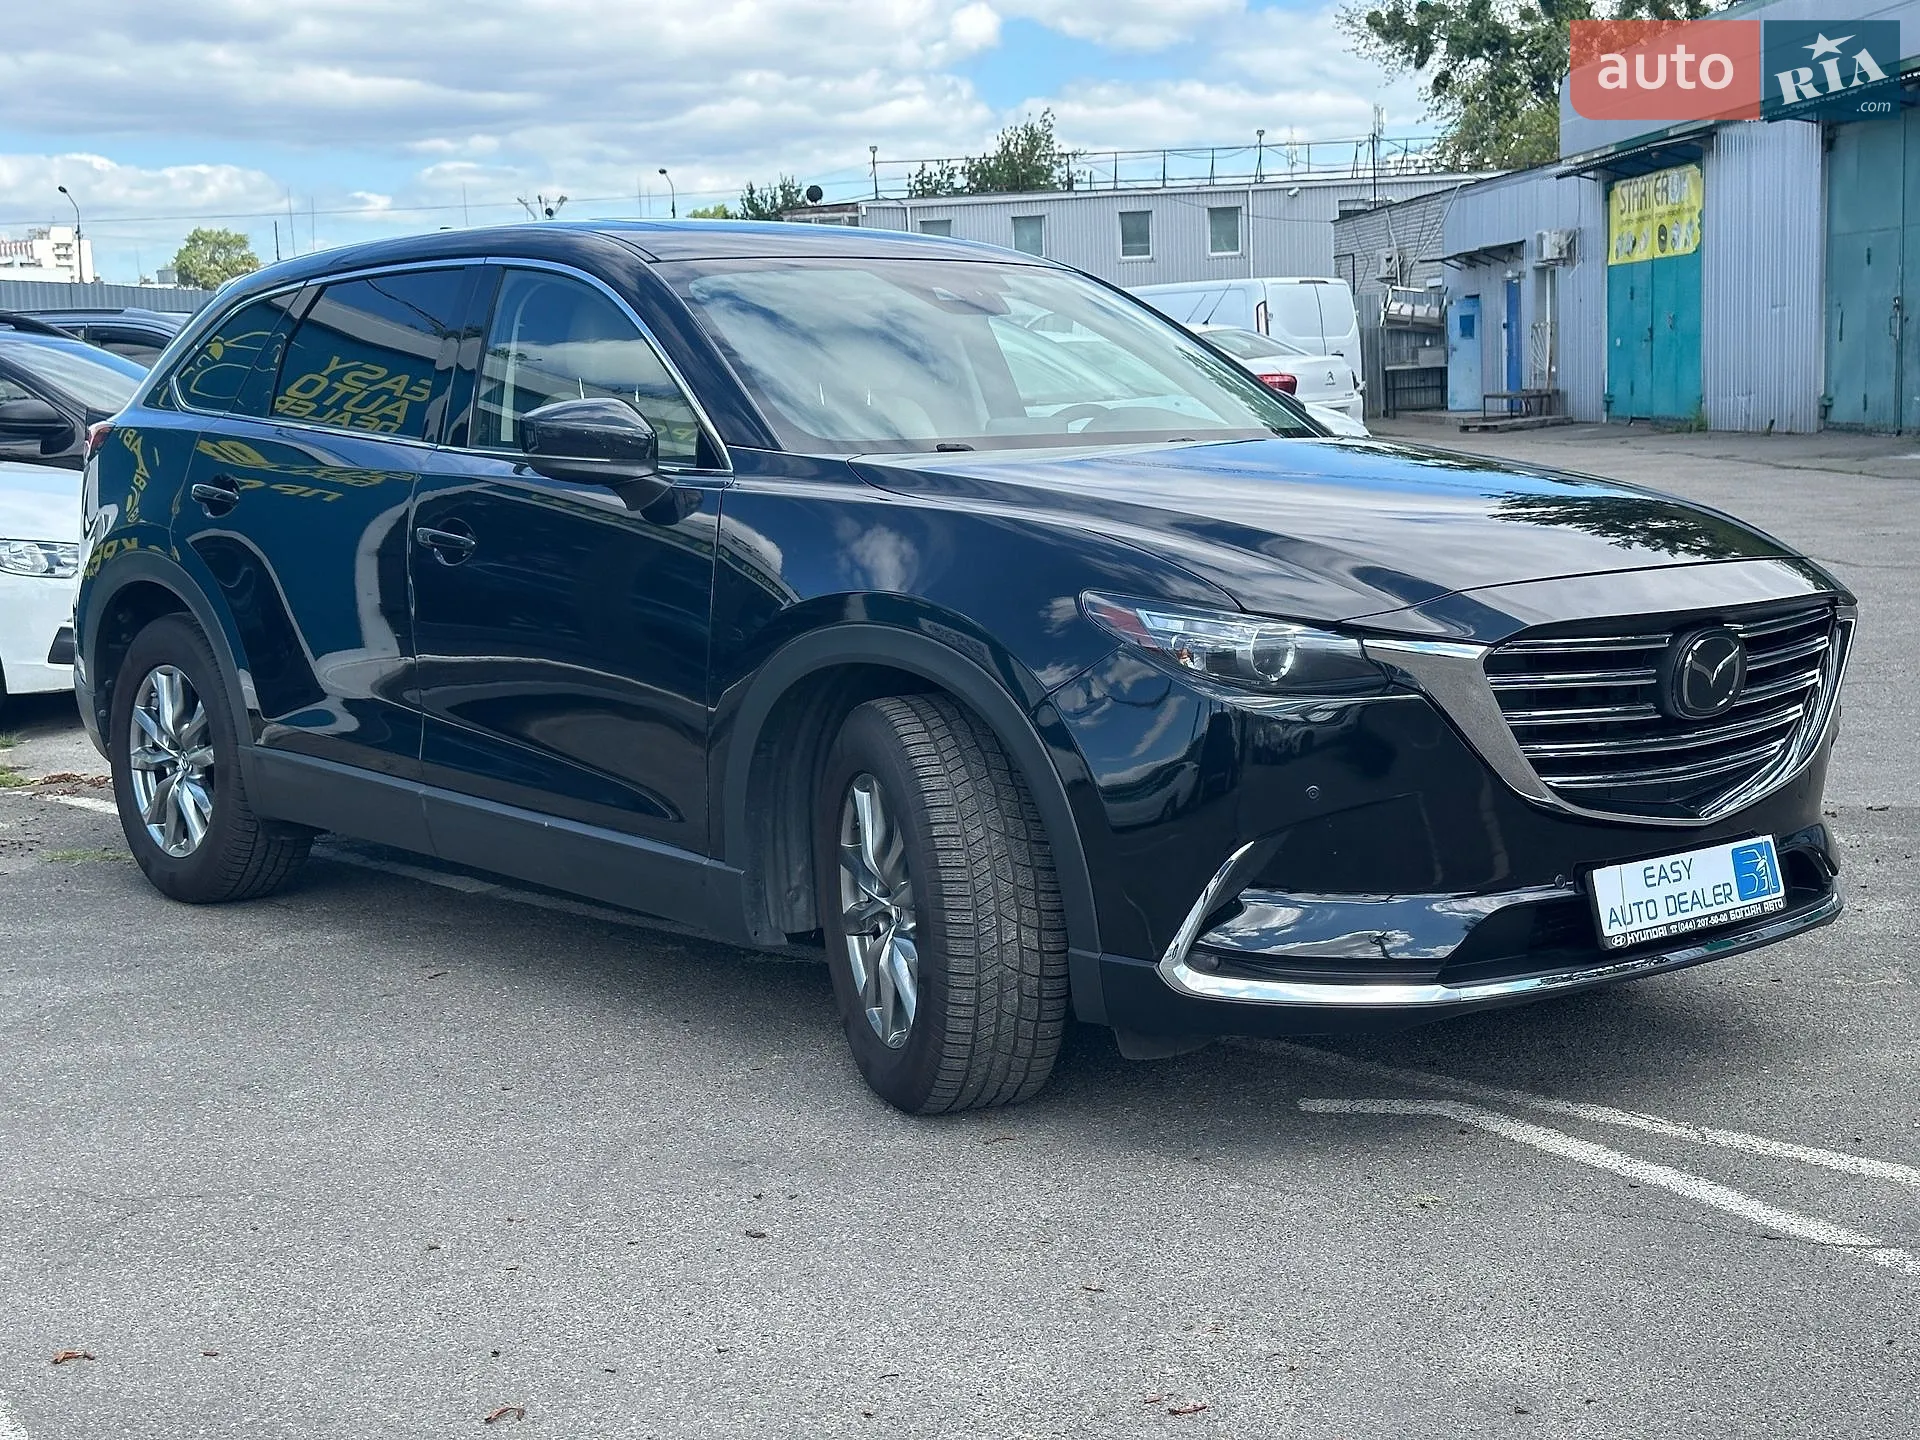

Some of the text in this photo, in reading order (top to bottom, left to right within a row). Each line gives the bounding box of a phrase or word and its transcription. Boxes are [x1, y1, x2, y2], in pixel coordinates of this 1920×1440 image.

[1643, 858, 1693, 888] EASY
[1608, 882, 1733, 930] AUTO DEALER
[1628, 926, 1668, 944] HYUNDAI
